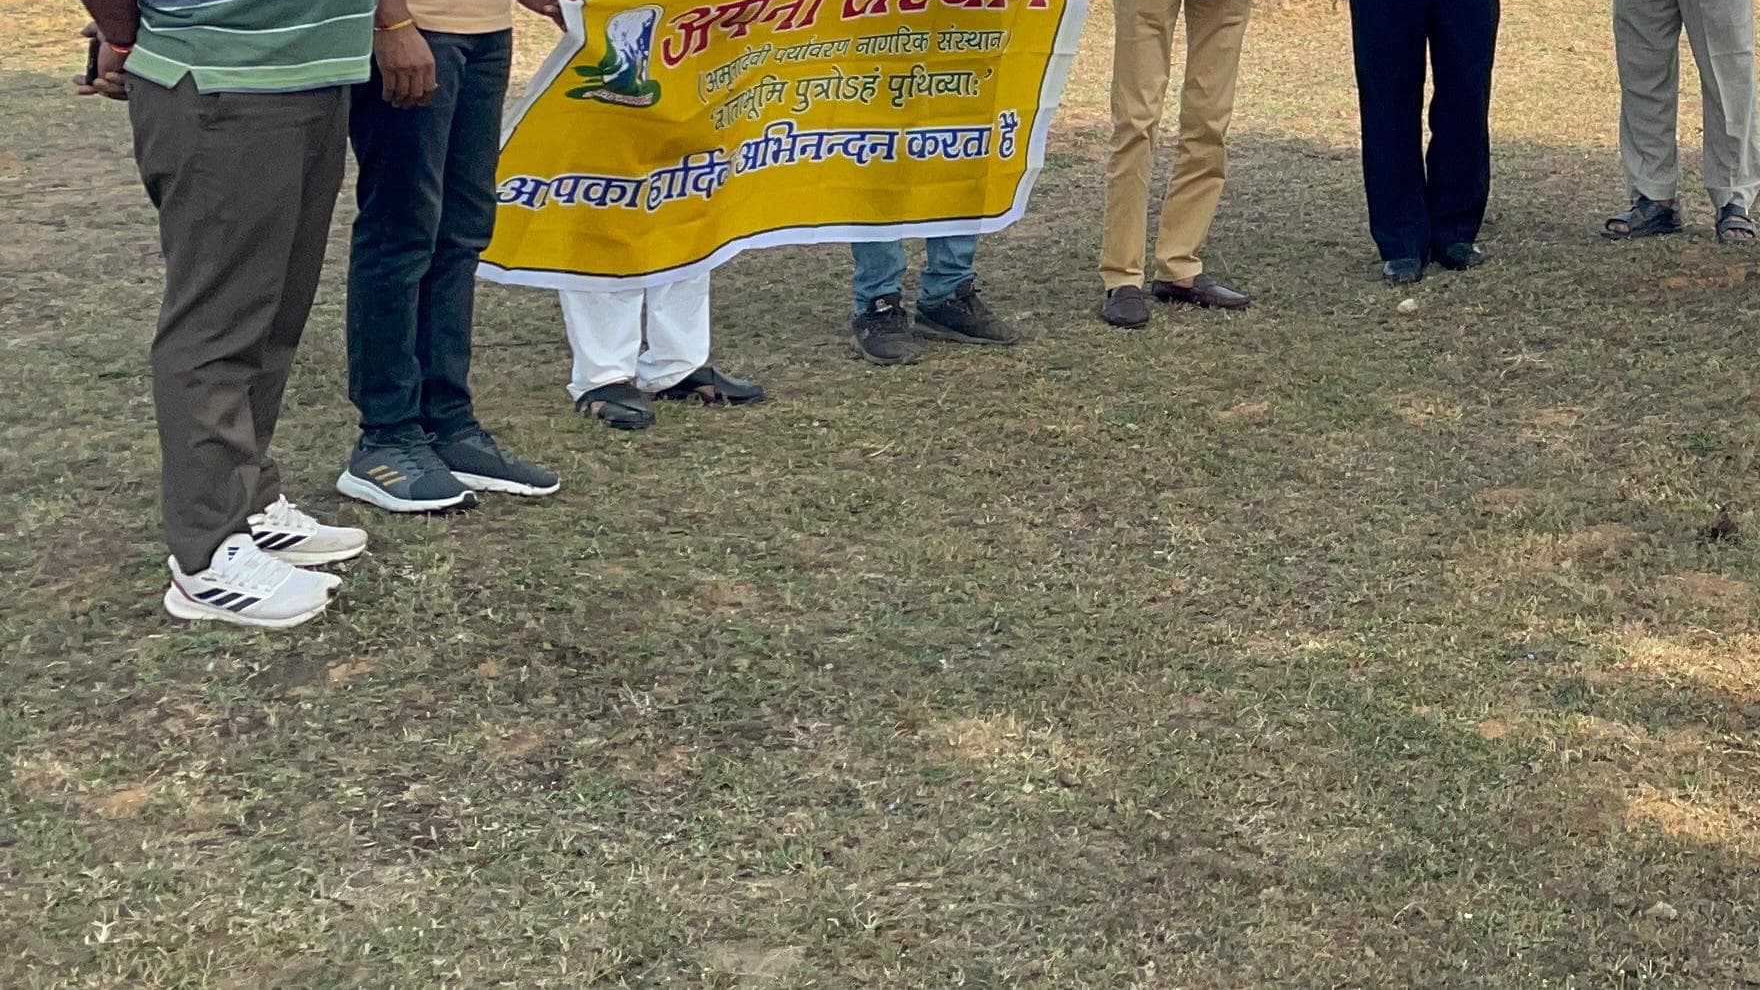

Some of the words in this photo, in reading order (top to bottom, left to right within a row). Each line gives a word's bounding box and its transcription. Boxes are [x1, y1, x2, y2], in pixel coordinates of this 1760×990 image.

[856, 26, 930, 55] नागरिक
[498, 176, 645, 208] आपका
[736, 121, 898, 173] अभिनन्दन
[906, 127, 992, 159] करता
[999, 112, 1019, 159] है
